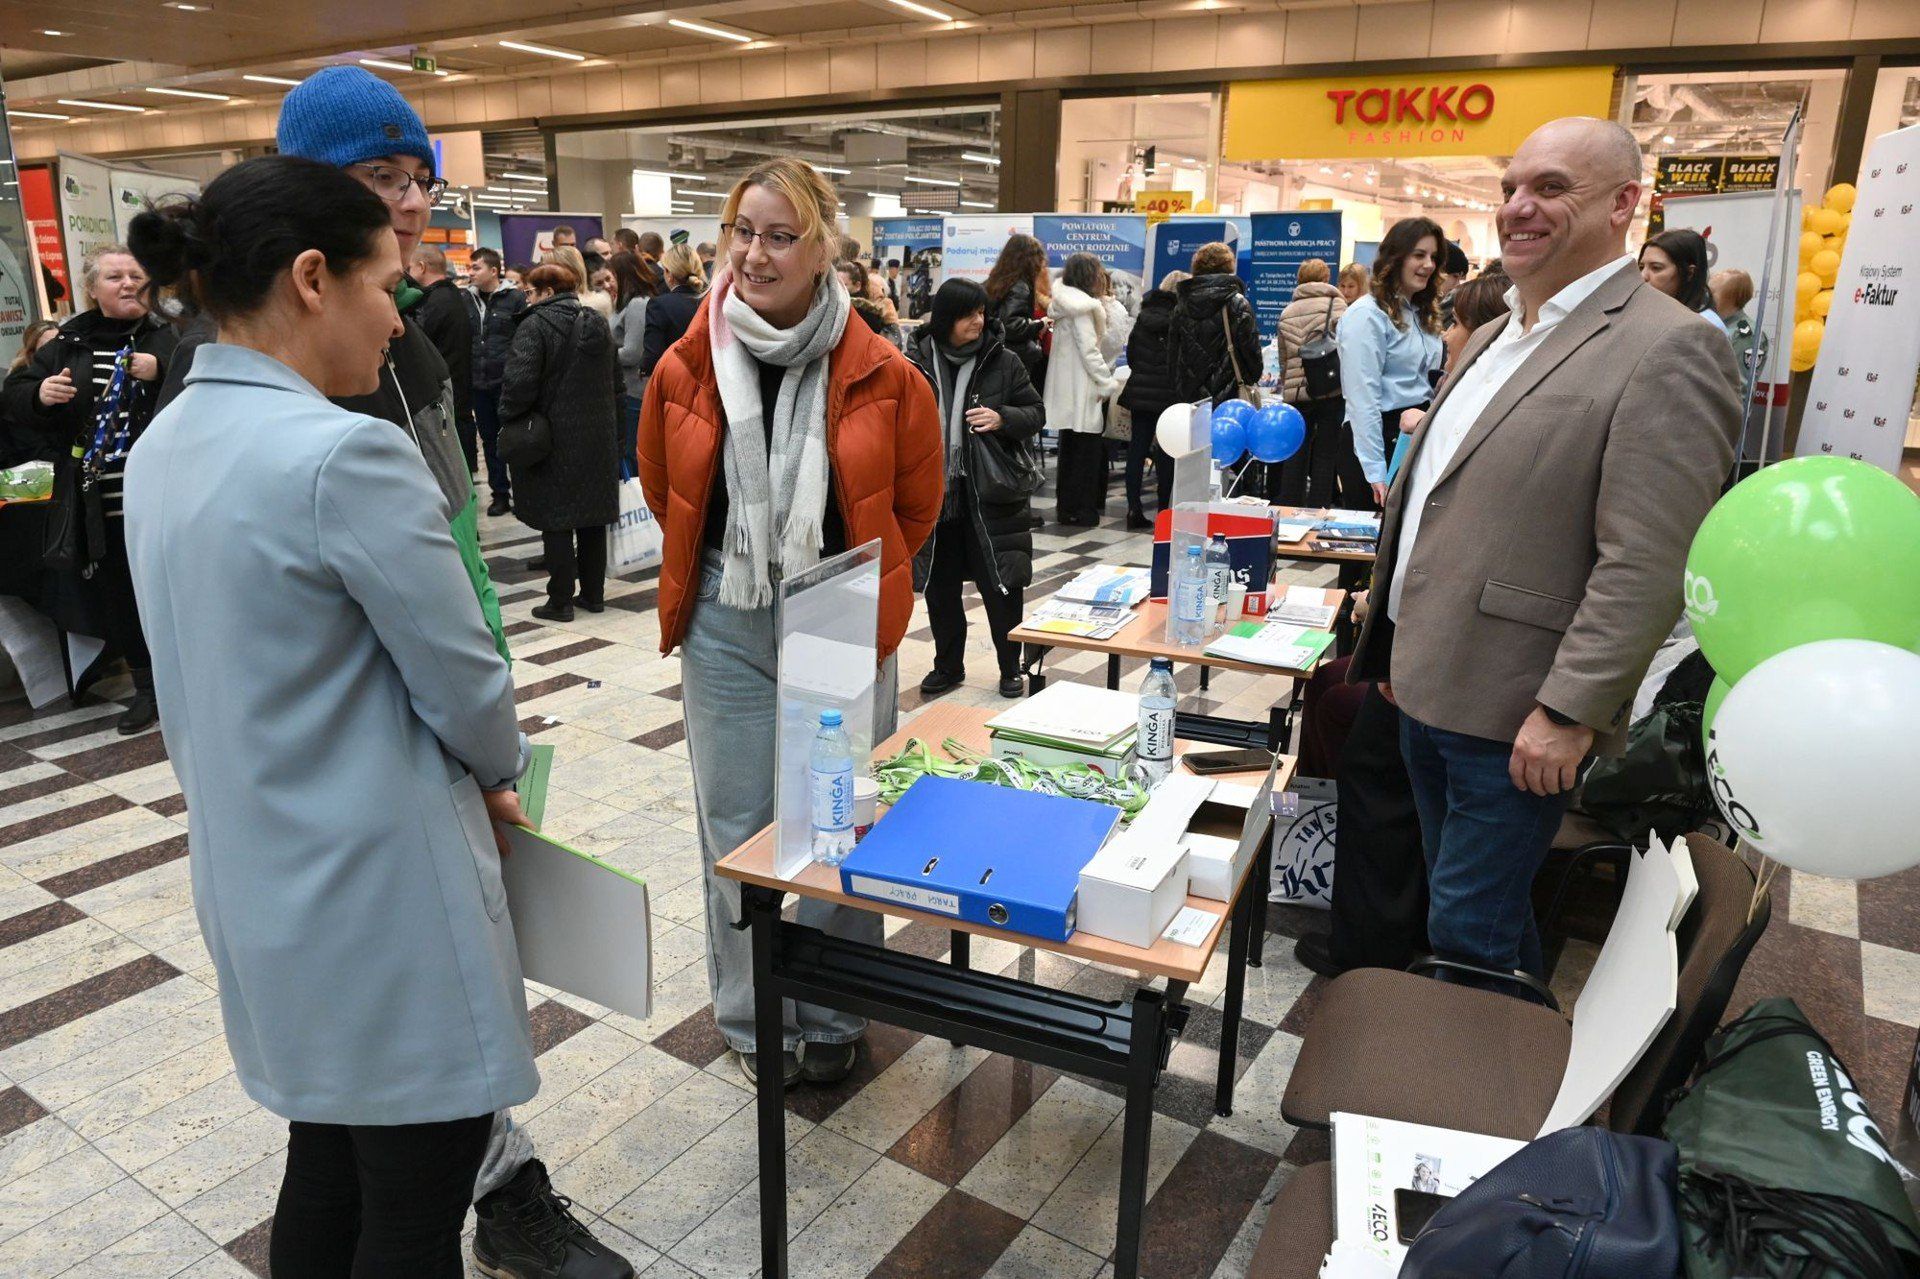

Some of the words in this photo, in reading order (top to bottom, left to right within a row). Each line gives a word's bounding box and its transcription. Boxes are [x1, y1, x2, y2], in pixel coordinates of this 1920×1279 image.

[1349, 129, 1464, 145] FASHION
[1668, 163, 1713, 173] BLACK
[1730, 163, 1776, 173] BLACK
[1671, 172, 1709, 182] WEEK
[1733, 173, 1773, 183] WEEK
[1061, 222, 1117, 231] POWIATOWE
[1066, 233, 1111, 241] CENTRUM
[1046, 243, 1085, 251] POMOCY
[1087, 244, 1130, 252] RODZINIE
[1860, 266, 1879, 280] Krajowy
[1880, 266, 1903, 279] System
[1854, 283, 1898, 306] e-Faktur
[1195, 586, 1204, 617] KINGA
[1146, 711, 1159, 756] KINGA
[831, 775, 844, 826] KINGA
[1806, 1050, 1829, 1087] GREEN
